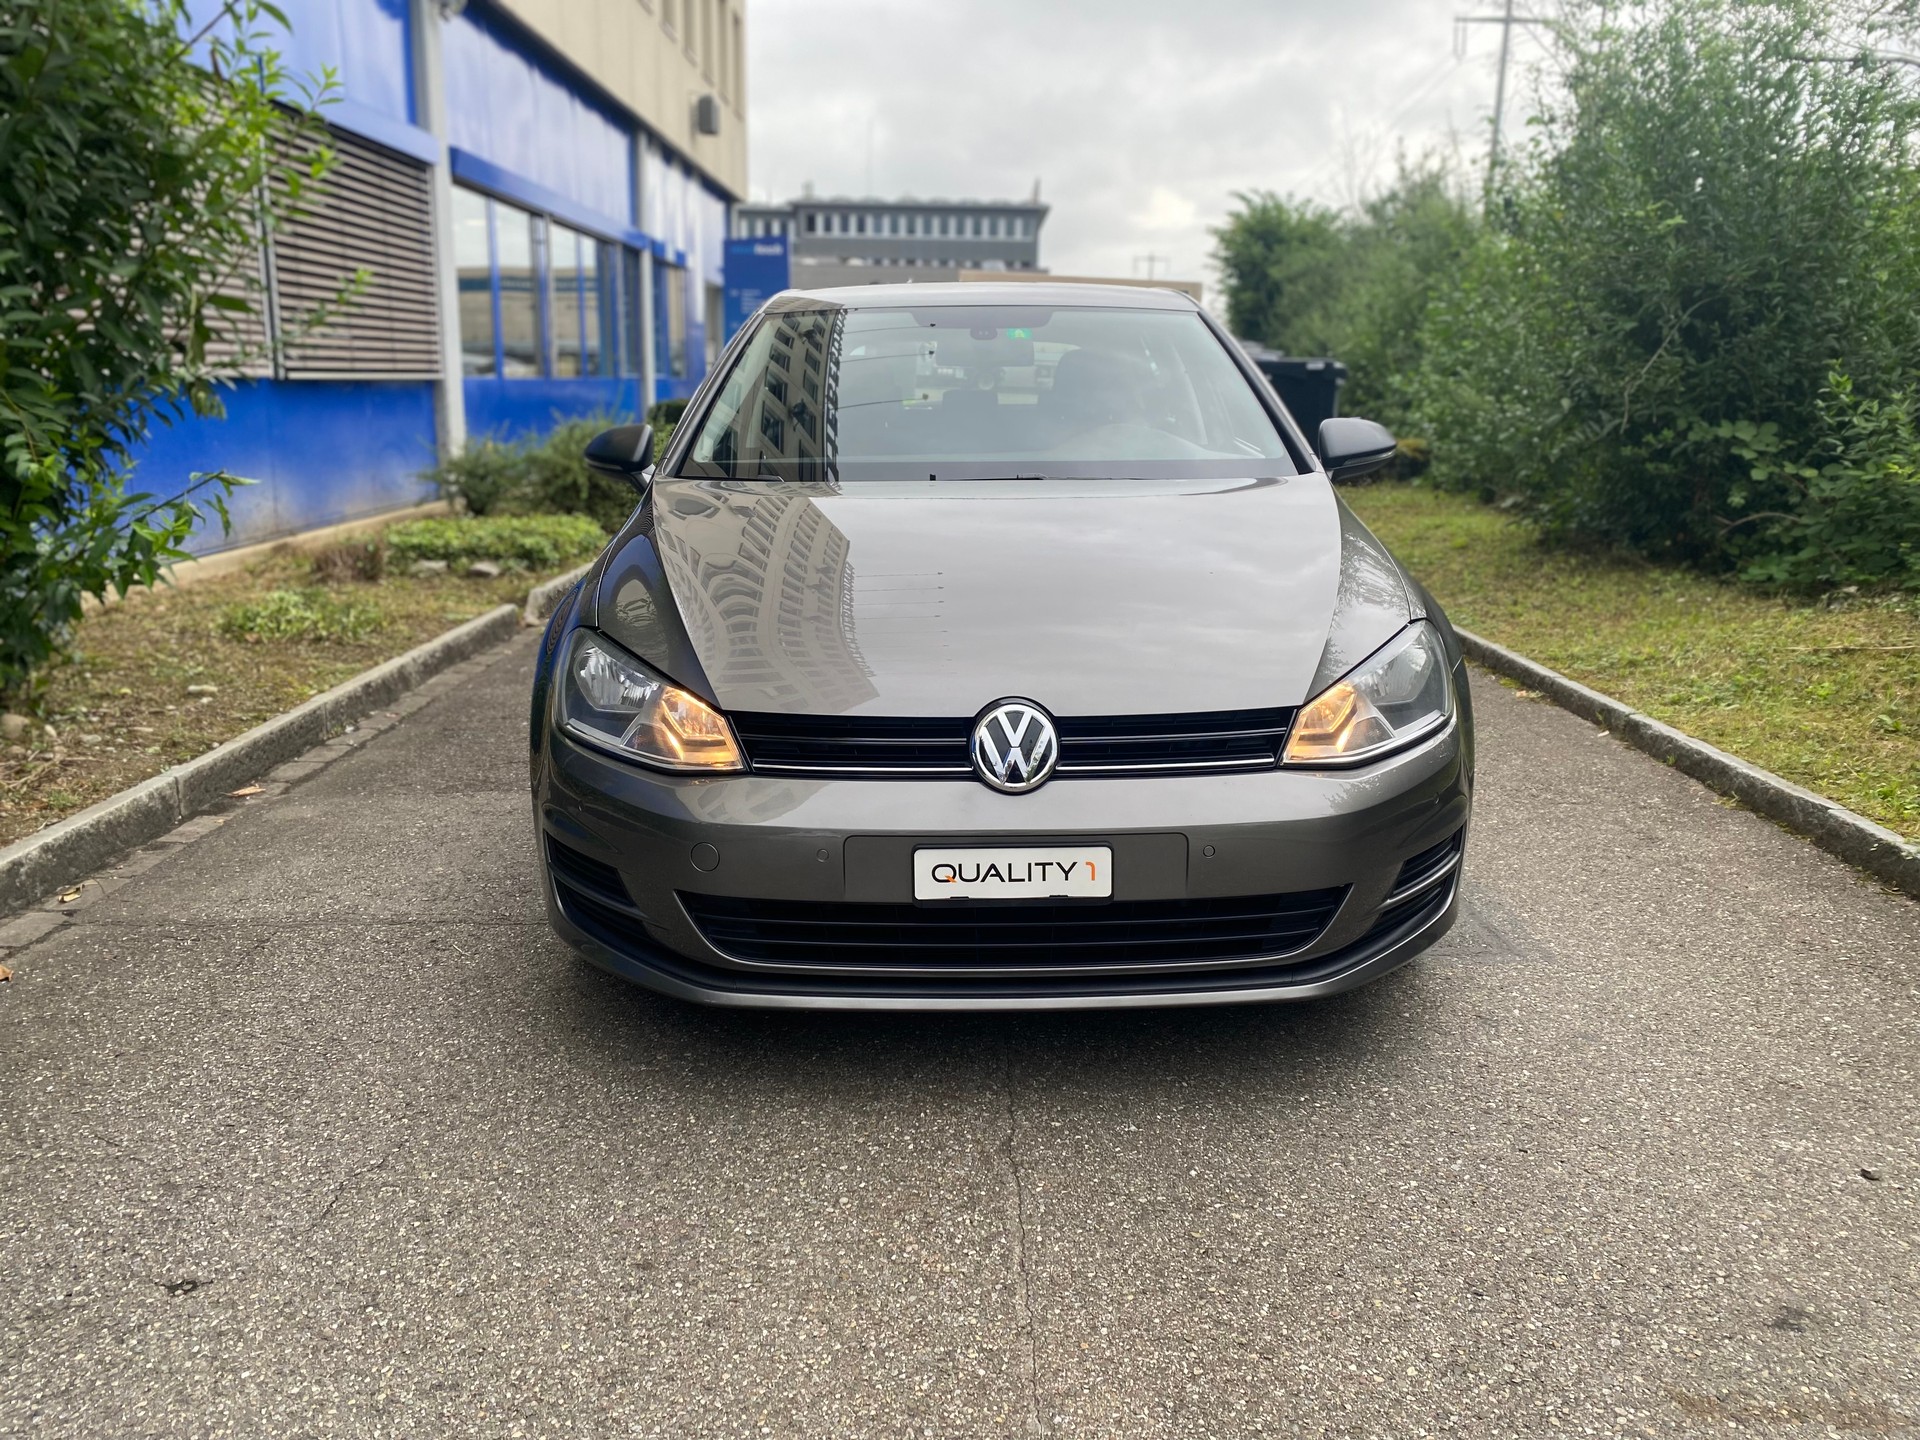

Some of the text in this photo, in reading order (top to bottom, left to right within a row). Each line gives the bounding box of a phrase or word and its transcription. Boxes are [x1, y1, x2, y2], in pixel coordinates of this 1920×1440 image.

[974, 703, 1058, 788] VW
[931, 861, 1096, 883] QUALITY 1
